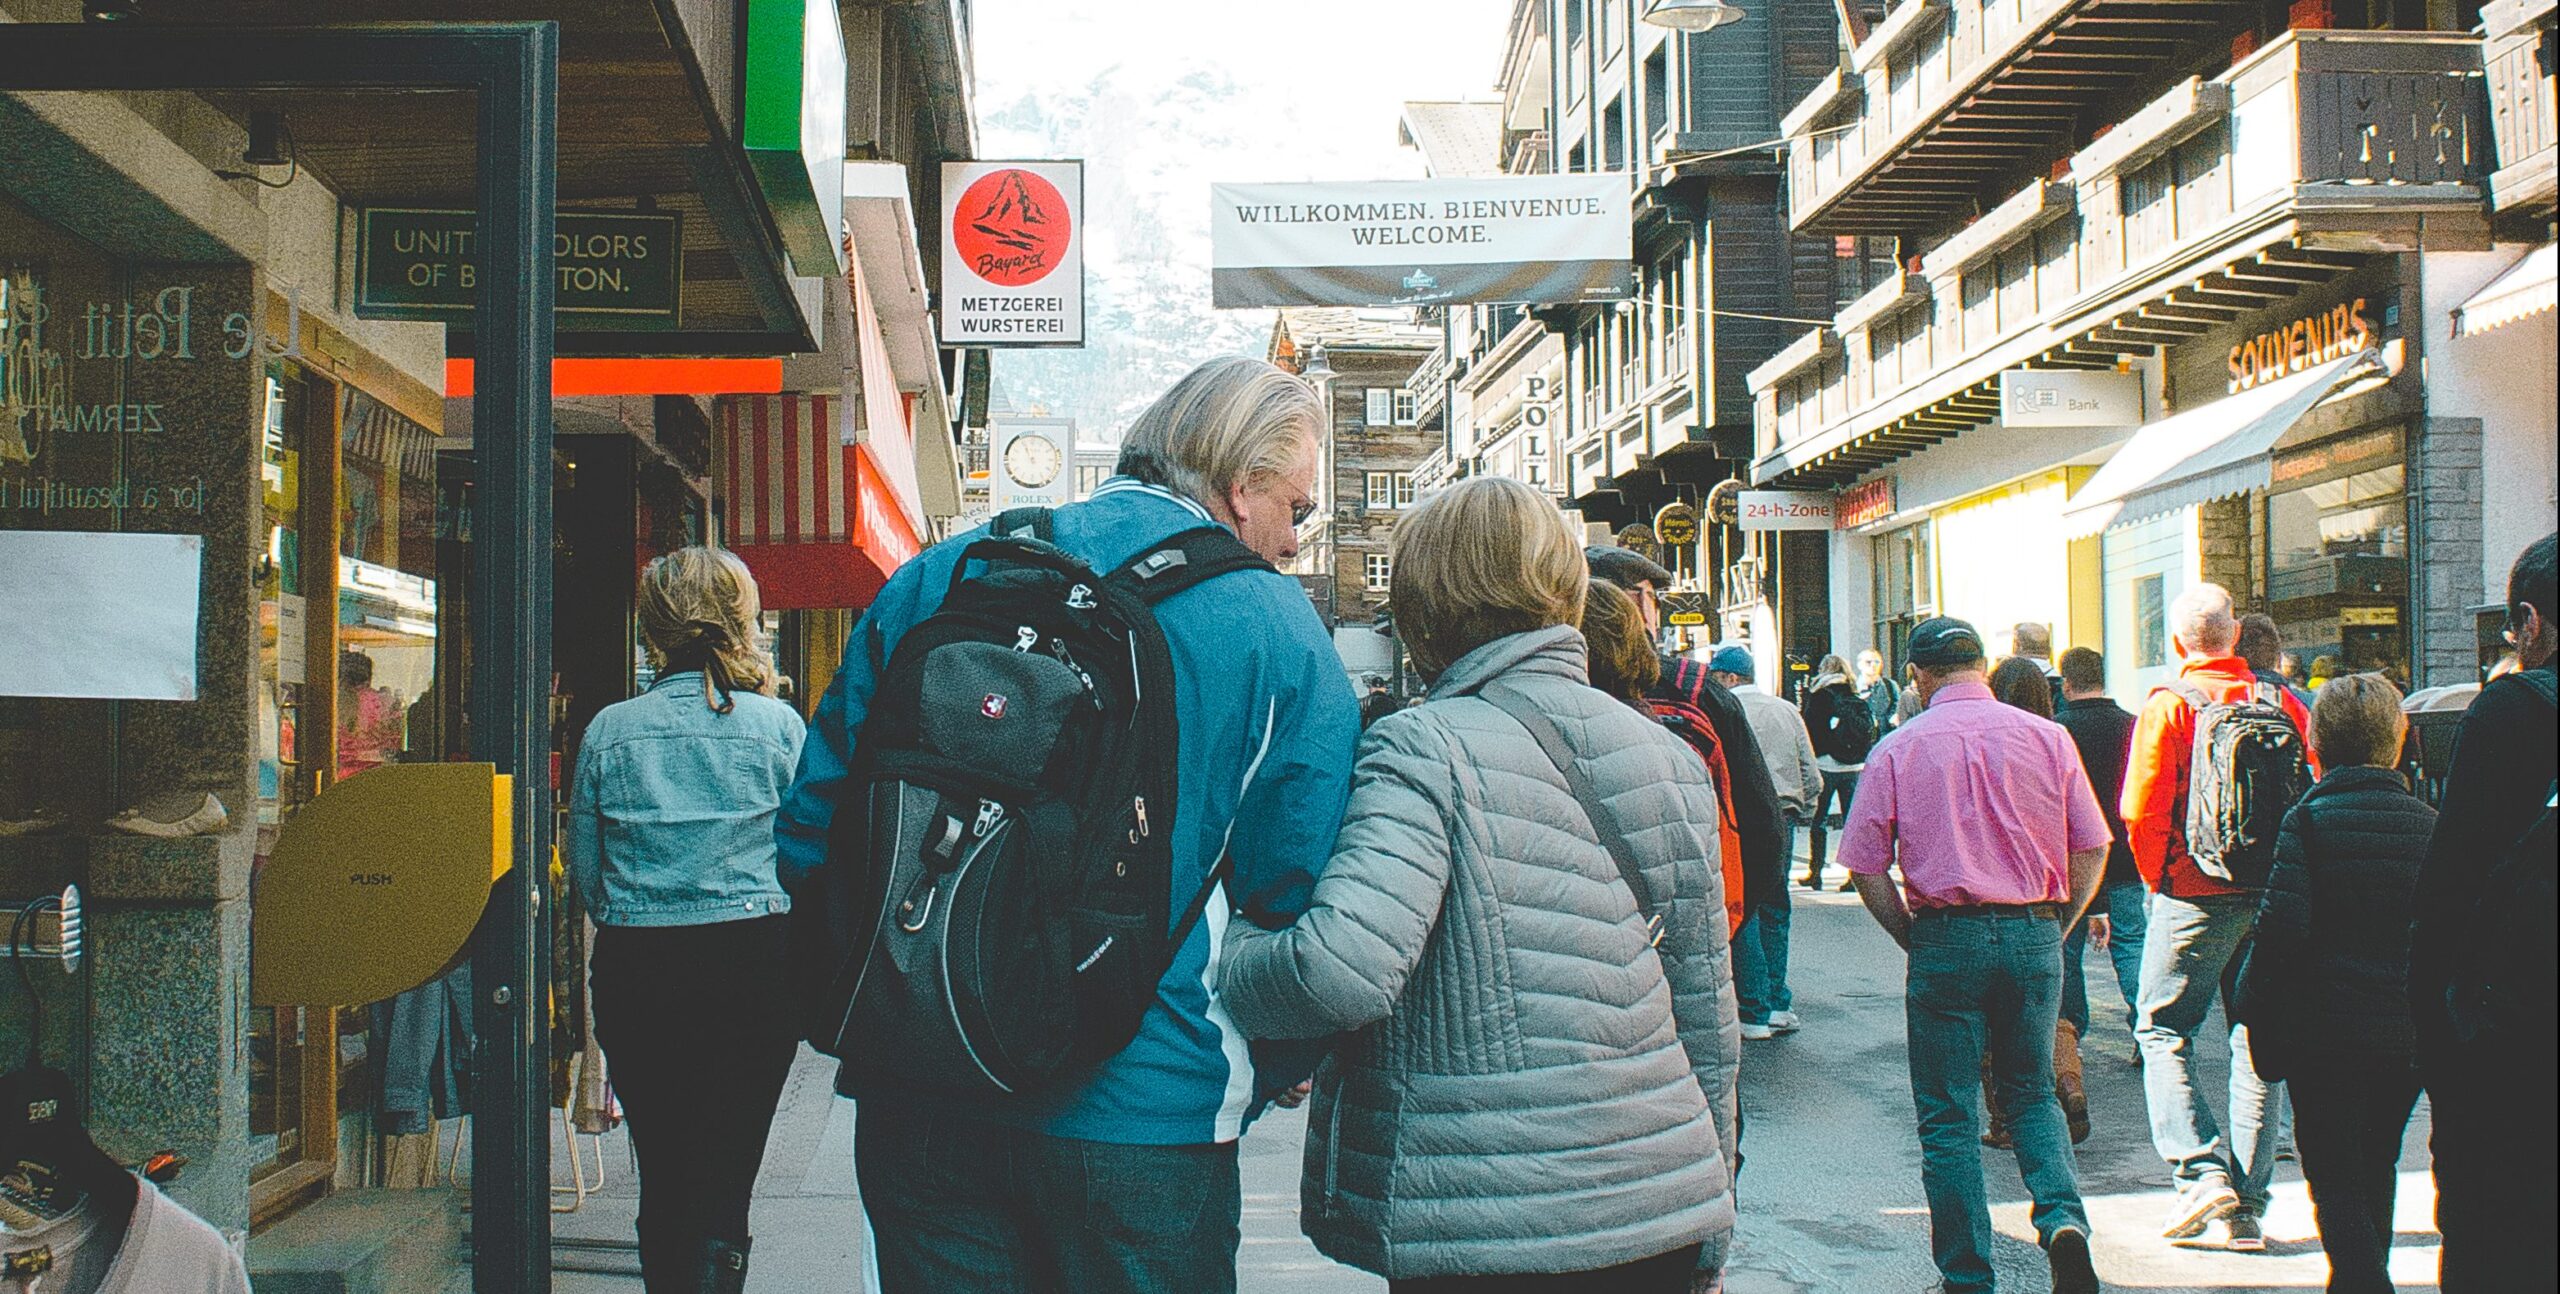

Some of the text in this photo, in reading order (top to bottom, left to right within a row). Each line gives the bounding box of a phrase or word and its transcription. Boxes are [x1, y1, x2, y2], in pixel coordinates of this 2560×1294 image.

[1237, 198, 1607, 223] WILLKOMMEN. BIENVENUE.
[1352, 225, 1493, 246] WELCOME.
[393, 229, 648, 260] UNIT OLORS
[407, 263, 447, 287] OF
[961, 297, 1063, 312] METZGEREI
[961, 318, 1064, 333] WURSTEREI
[2228, 298, 2369, 395] SOUVENIRS
[2068, 399, 2100, 411] Bank
[1012, 495, 1053, 504] ROLEX
[1747, 503, 1830, 518] 24-h-Zone
[350, 873, 393, 886] PUSH
